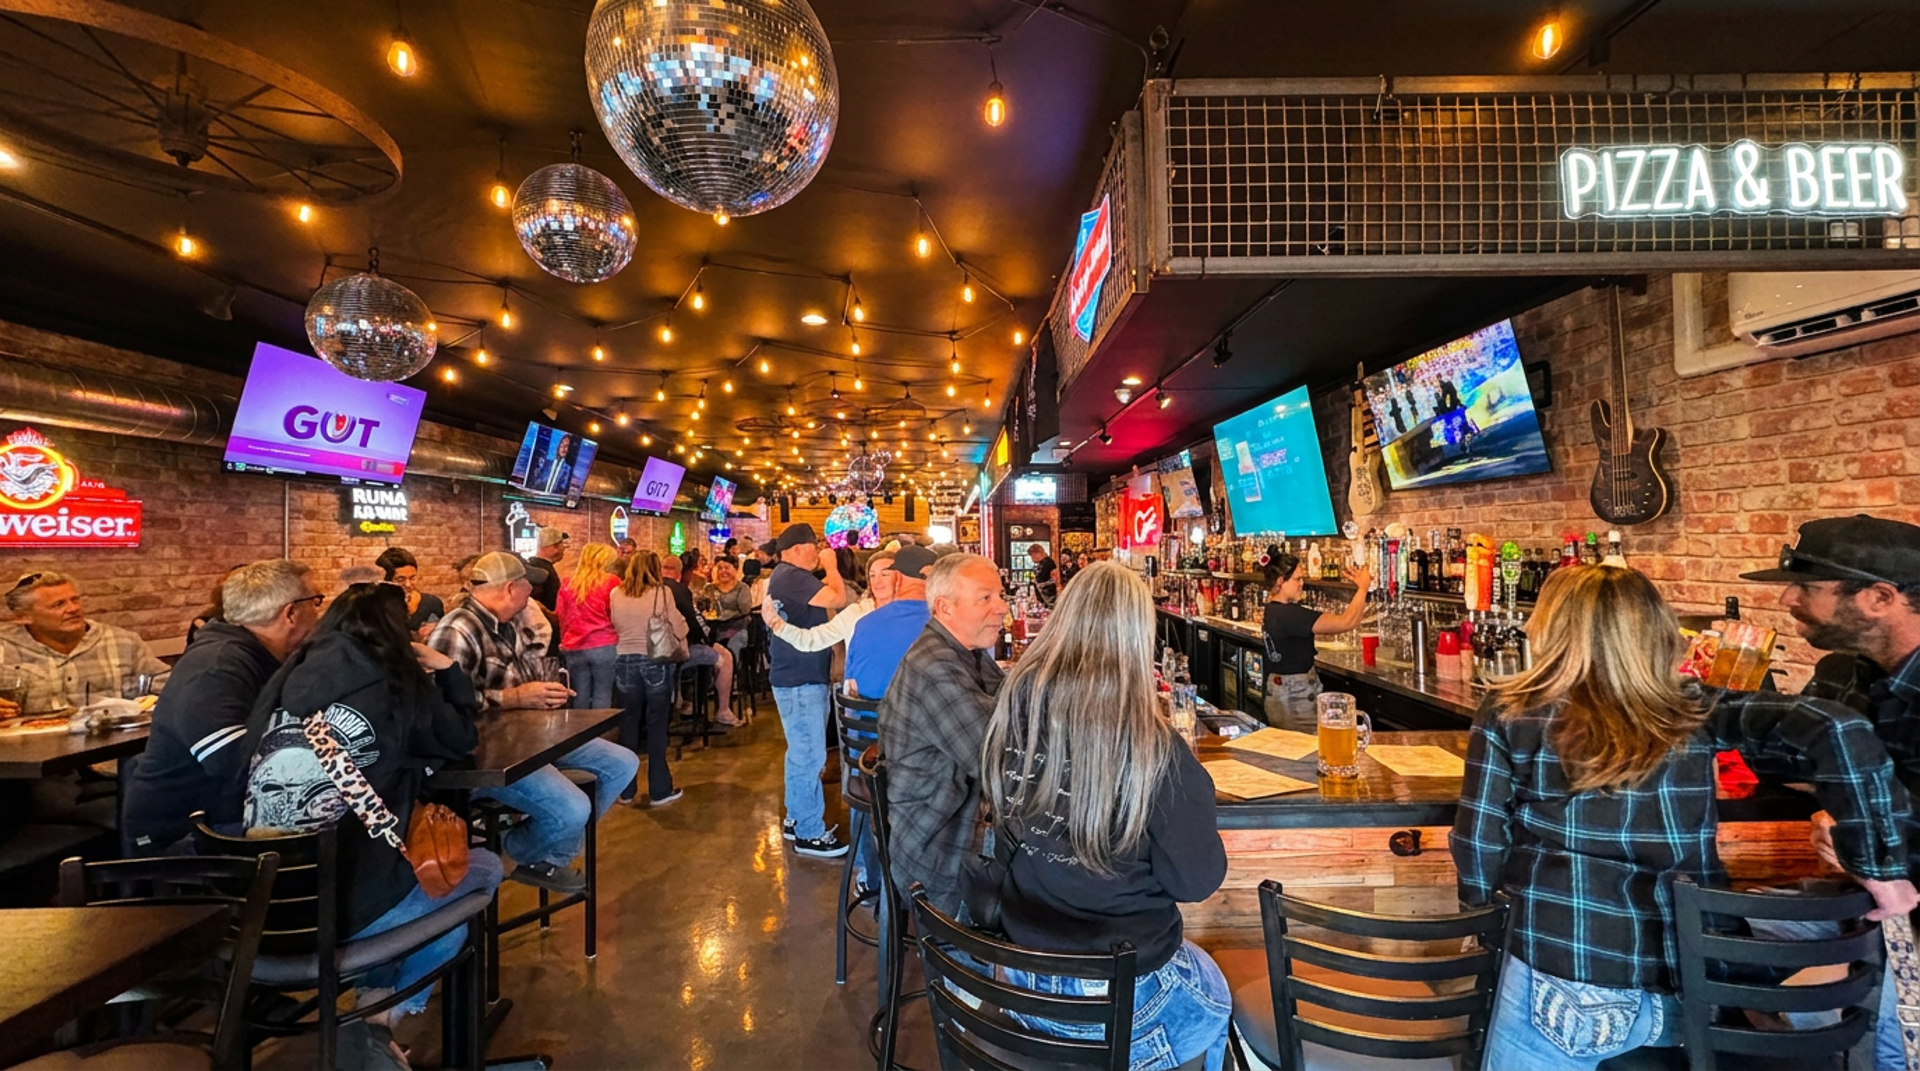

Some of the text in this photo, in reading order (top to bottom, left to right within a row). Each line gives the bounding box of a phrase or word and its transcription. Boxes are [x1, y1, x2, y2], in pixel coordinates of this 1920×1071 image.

[1566, 143, 1908, 213] PIZZA & BEER
[283, 404, 380, 448] GUT
